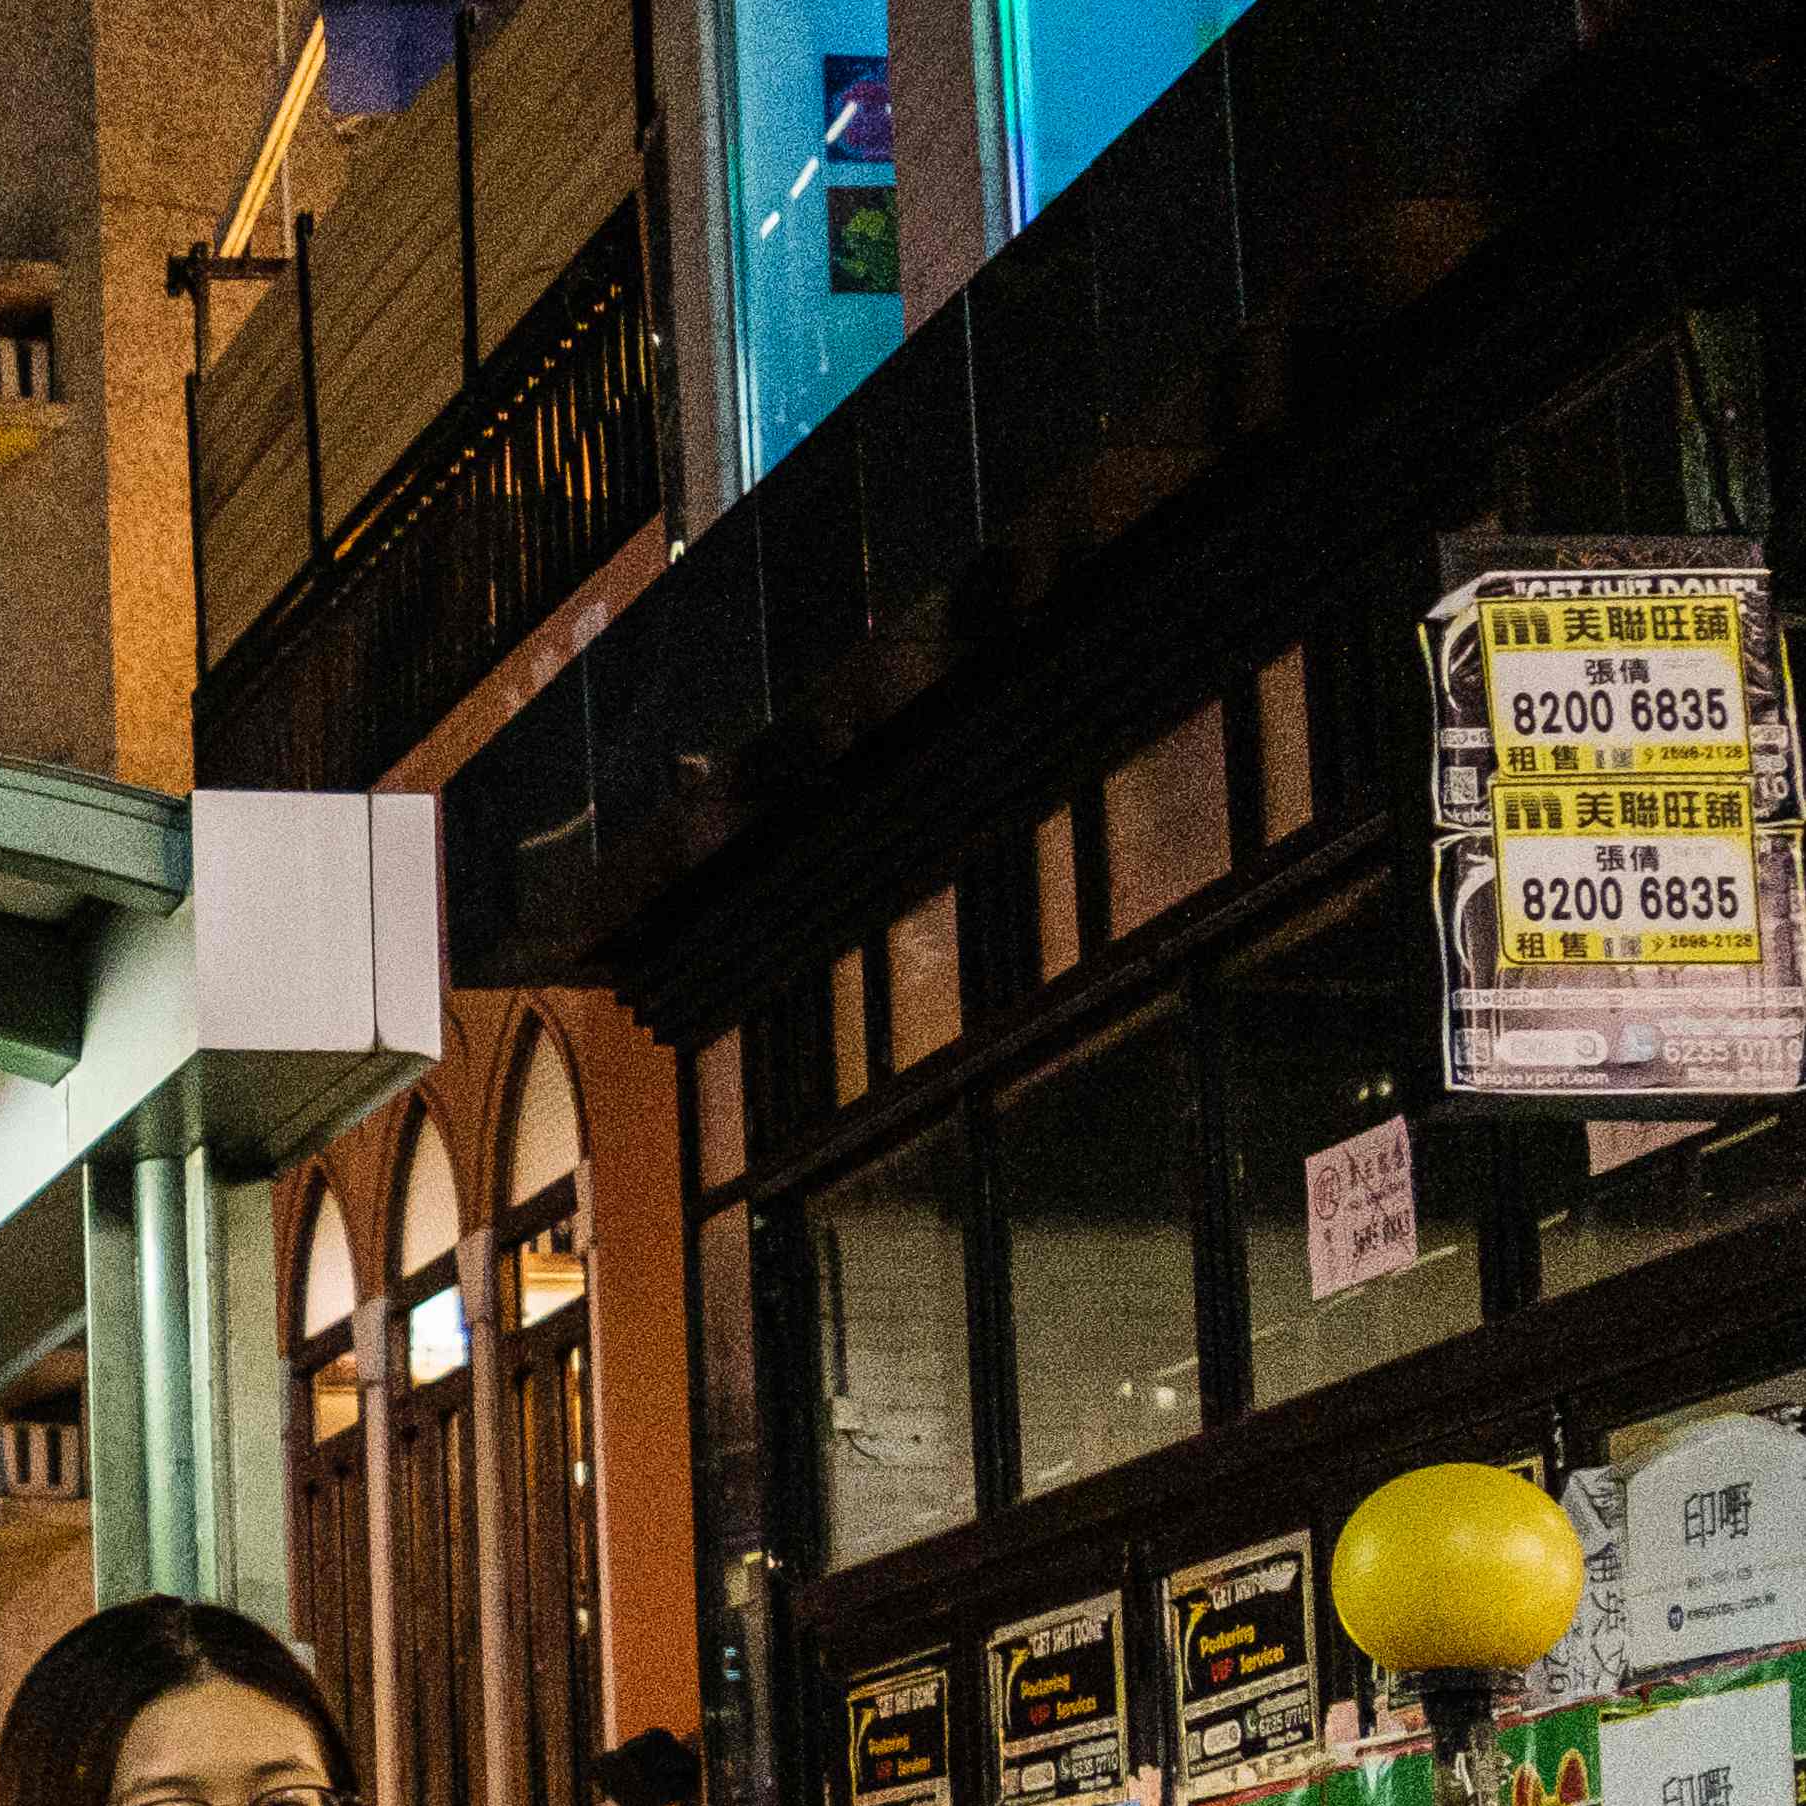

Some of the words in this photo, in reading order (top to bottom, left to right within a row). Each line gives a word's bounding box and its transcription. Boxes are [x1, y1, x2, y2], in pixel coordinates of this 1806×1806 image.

[1513, 691, 1614, 736] 8200
[1631, 687, 1729, 734] 6835
[1521, 877, 1624, 922] 8200
[1639, 875, 1740, 920] 6835
[1662, 1039, 1730, 1063] 6235
[1199, 1623, 1257, 1657] Postering
